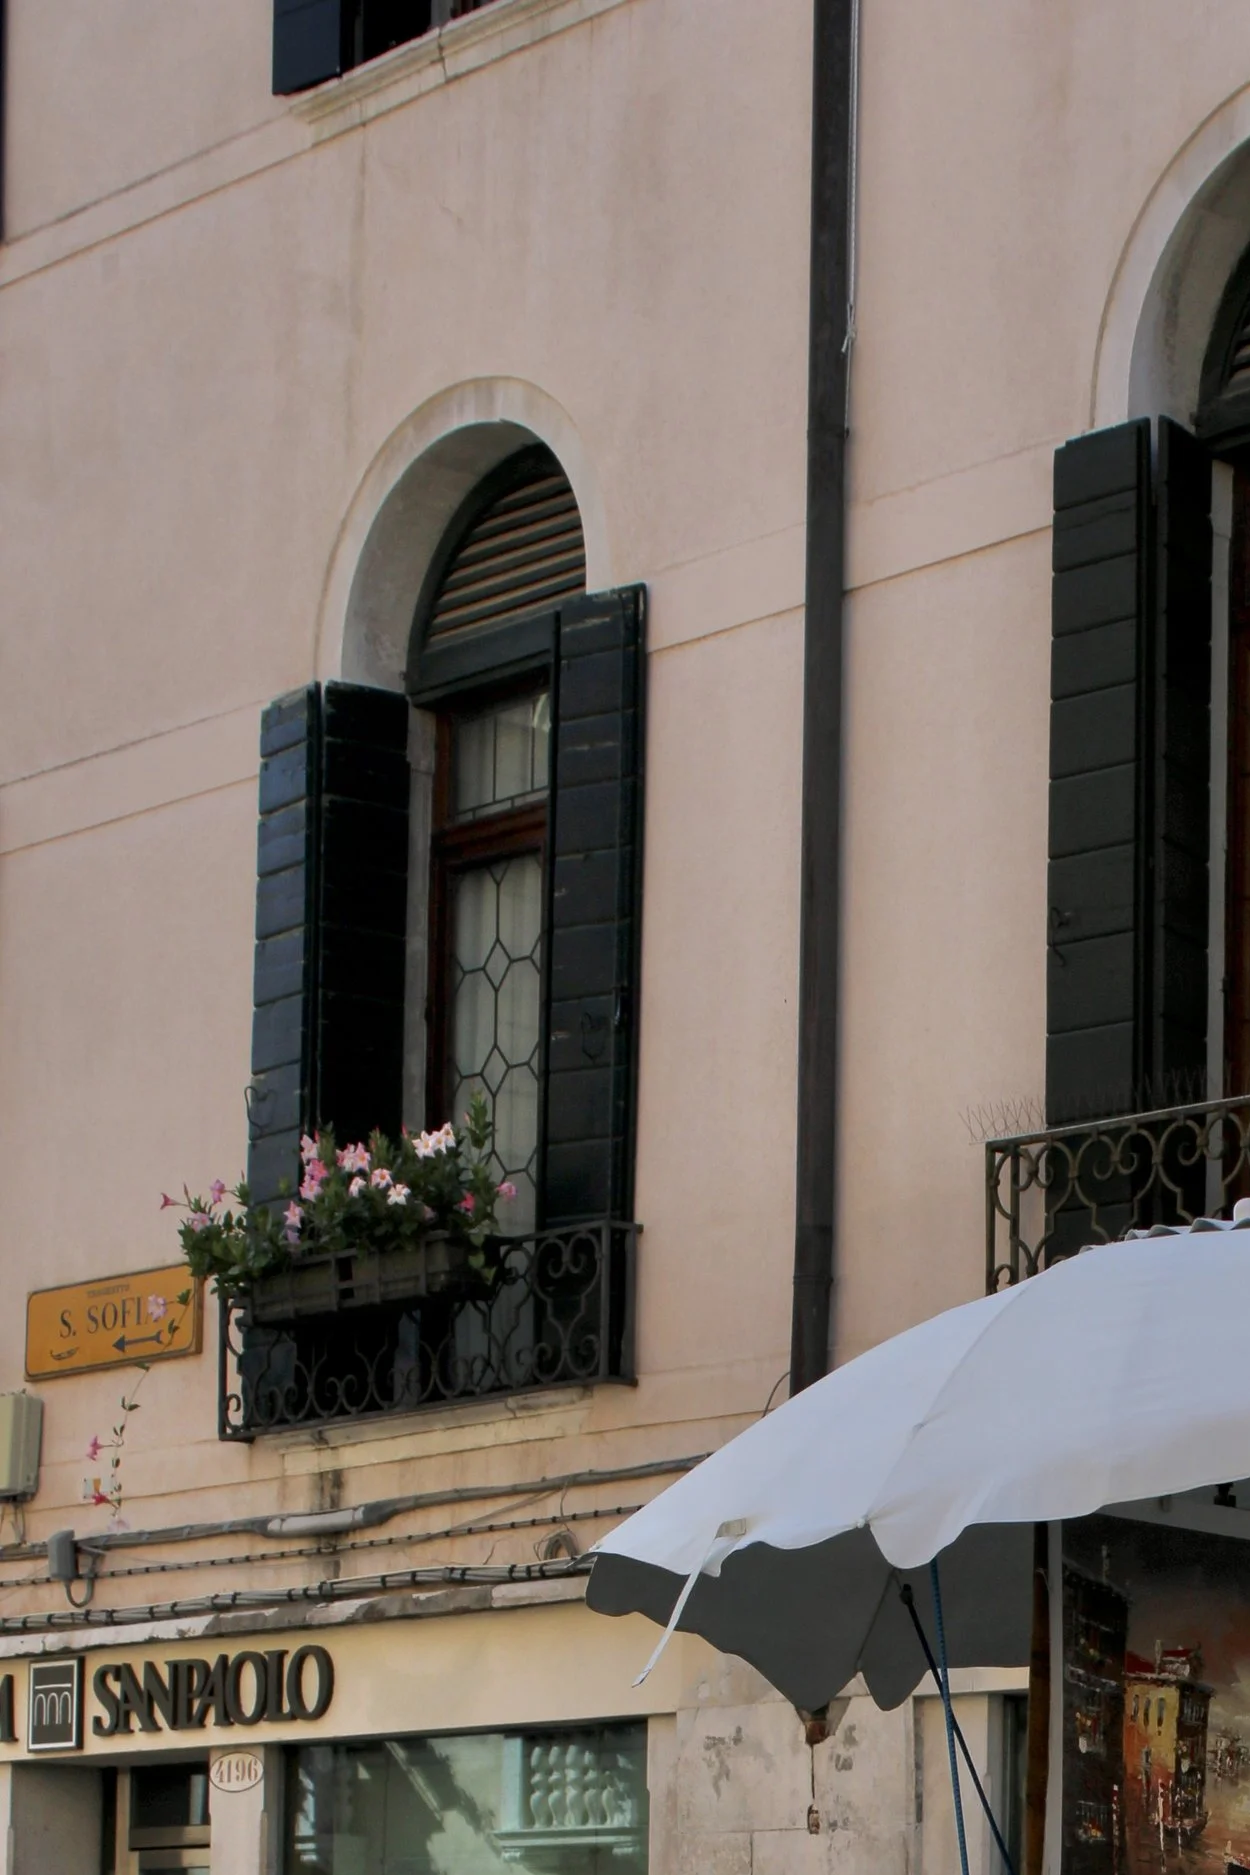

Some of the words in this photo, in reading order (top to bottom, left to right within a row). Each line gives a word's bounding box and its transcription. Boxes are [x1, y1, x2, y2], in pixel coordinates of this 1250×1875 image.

[59, 1308, 77, 1339] S.
[86, 1297, 160, 1334] SOFI
[92, 1644, 335, 1737] SANPAOLO
[214, 1757, 259, 1784] 4196
